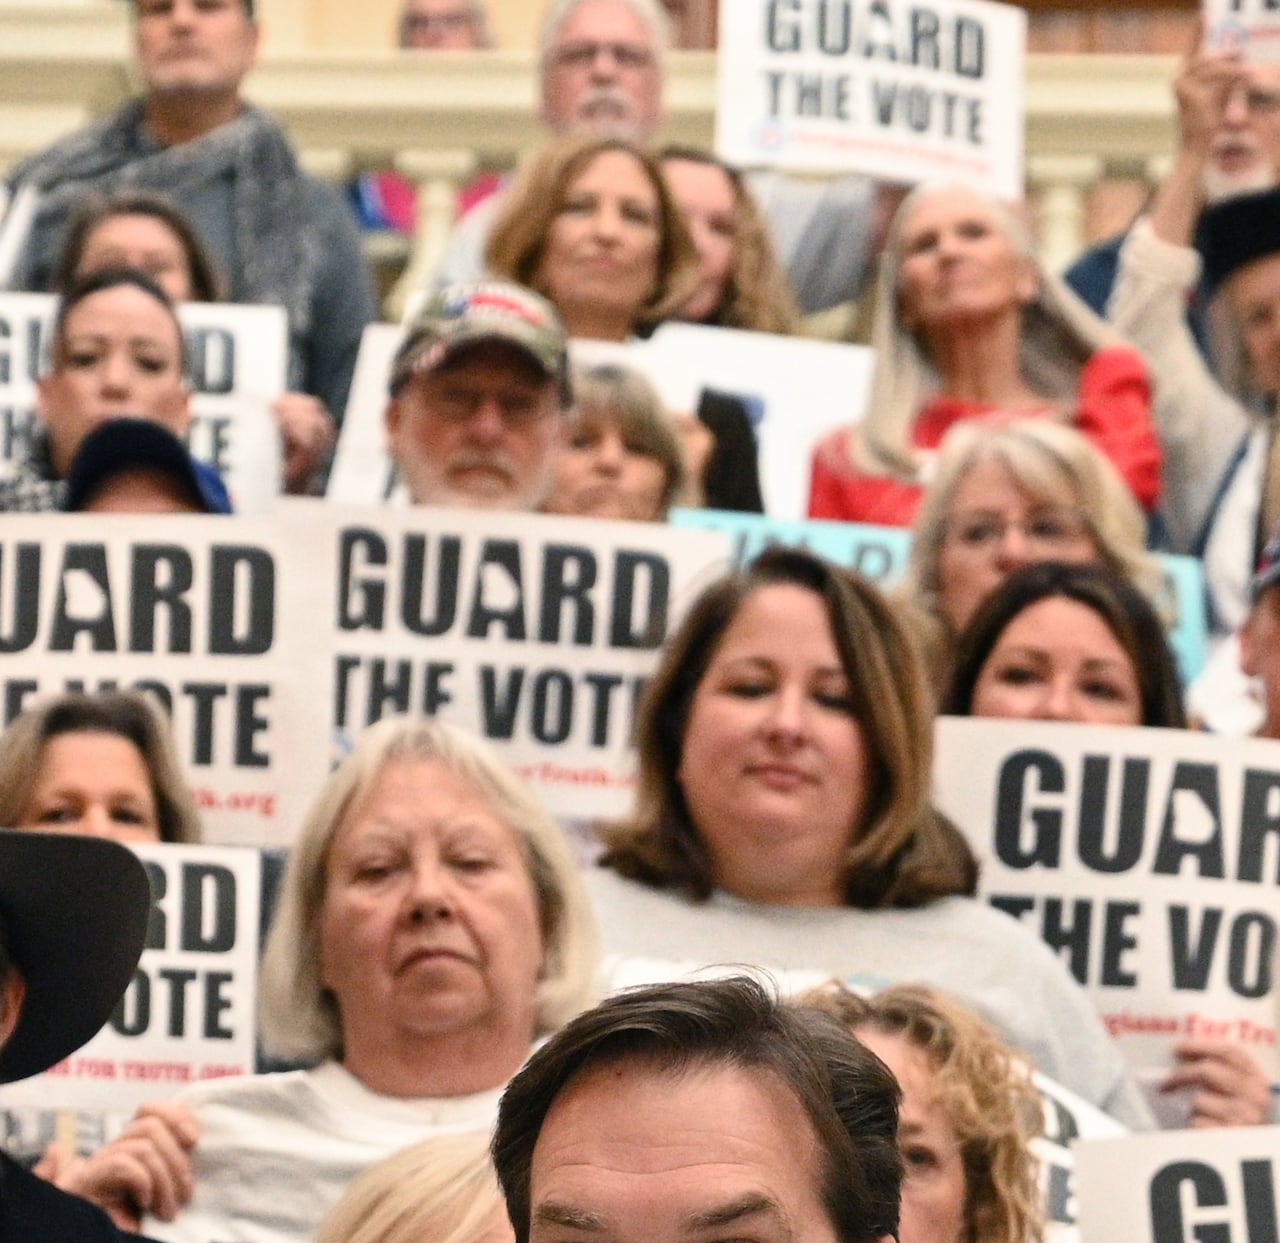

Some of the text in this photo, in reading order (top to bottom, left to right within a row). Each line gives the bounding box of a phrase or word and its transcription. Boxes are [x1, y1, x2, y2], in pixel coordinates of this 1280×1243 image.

[766, 0, 986, 80] GUARD
[766, 70, 984, 146] THE VOTE
[337, 526, 671, 650] GUARD
